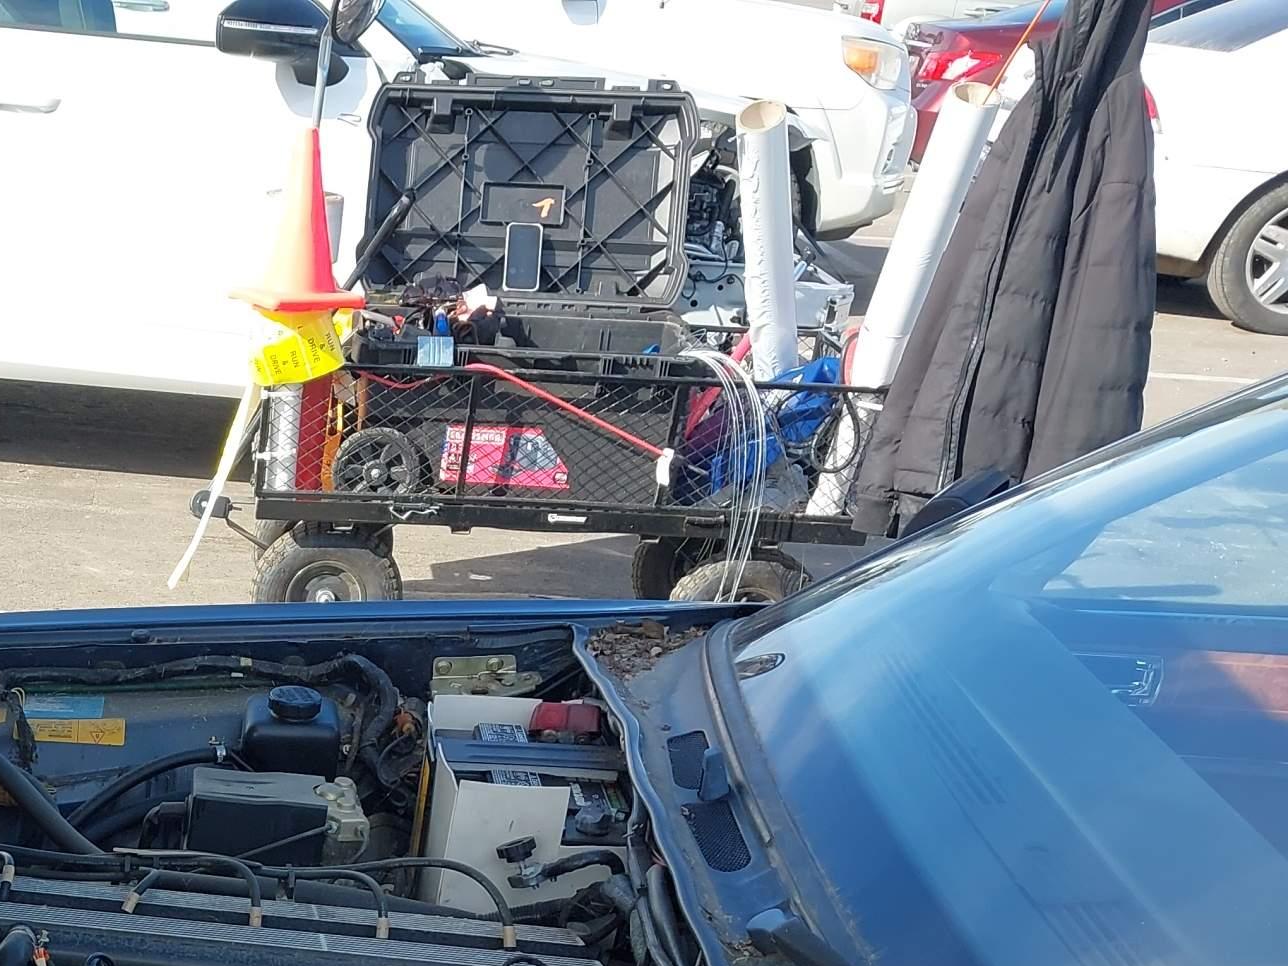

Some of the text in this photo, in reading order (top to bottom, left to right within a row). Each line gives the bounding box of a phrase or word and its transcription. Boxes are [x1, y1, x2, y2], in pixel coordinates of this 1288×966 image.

[307, 337, 321, 363] DRIVE
[325, 332, 336, 352] RUN
[270, 354, 282, 375] DRIVE
[289, 350, 302, 368] RUN
